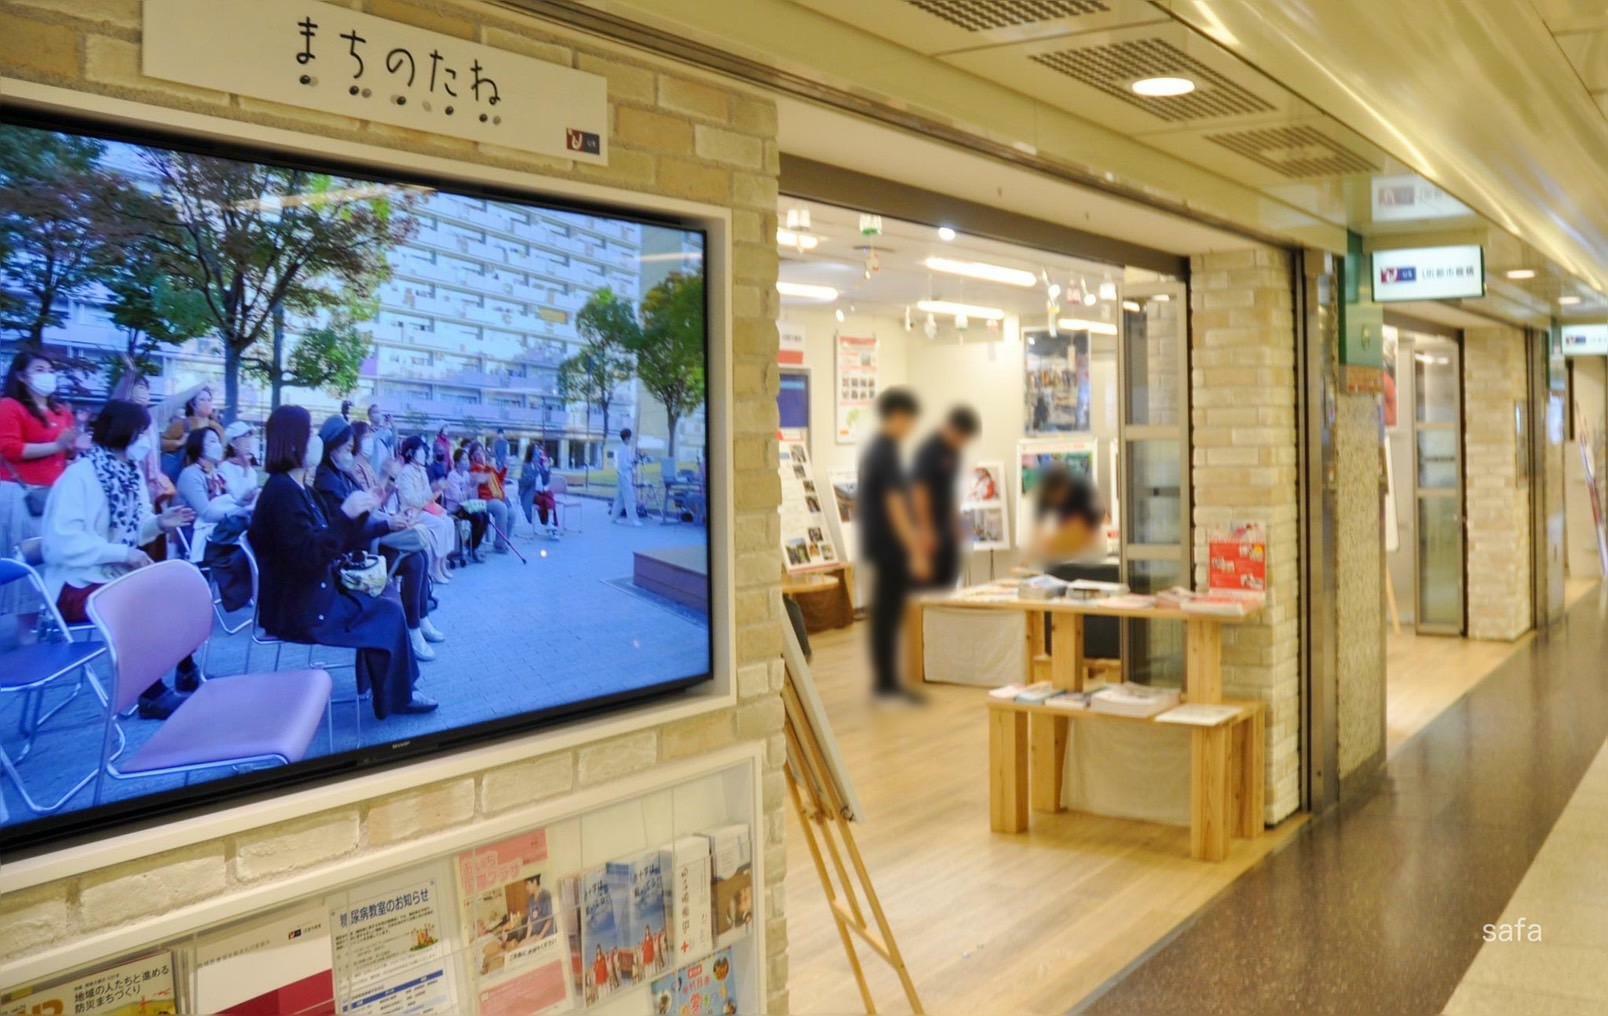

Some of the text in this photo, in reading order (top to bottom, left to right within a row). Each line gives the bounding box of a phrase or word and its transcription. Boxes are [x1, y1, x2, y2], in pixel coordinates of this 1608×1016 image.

[296, 16, 500, 106] まちのたね
[74, 965, 170, 1003] 地域の人たちと進める
[74, 985, 141, 1014] 防災まちづくり
